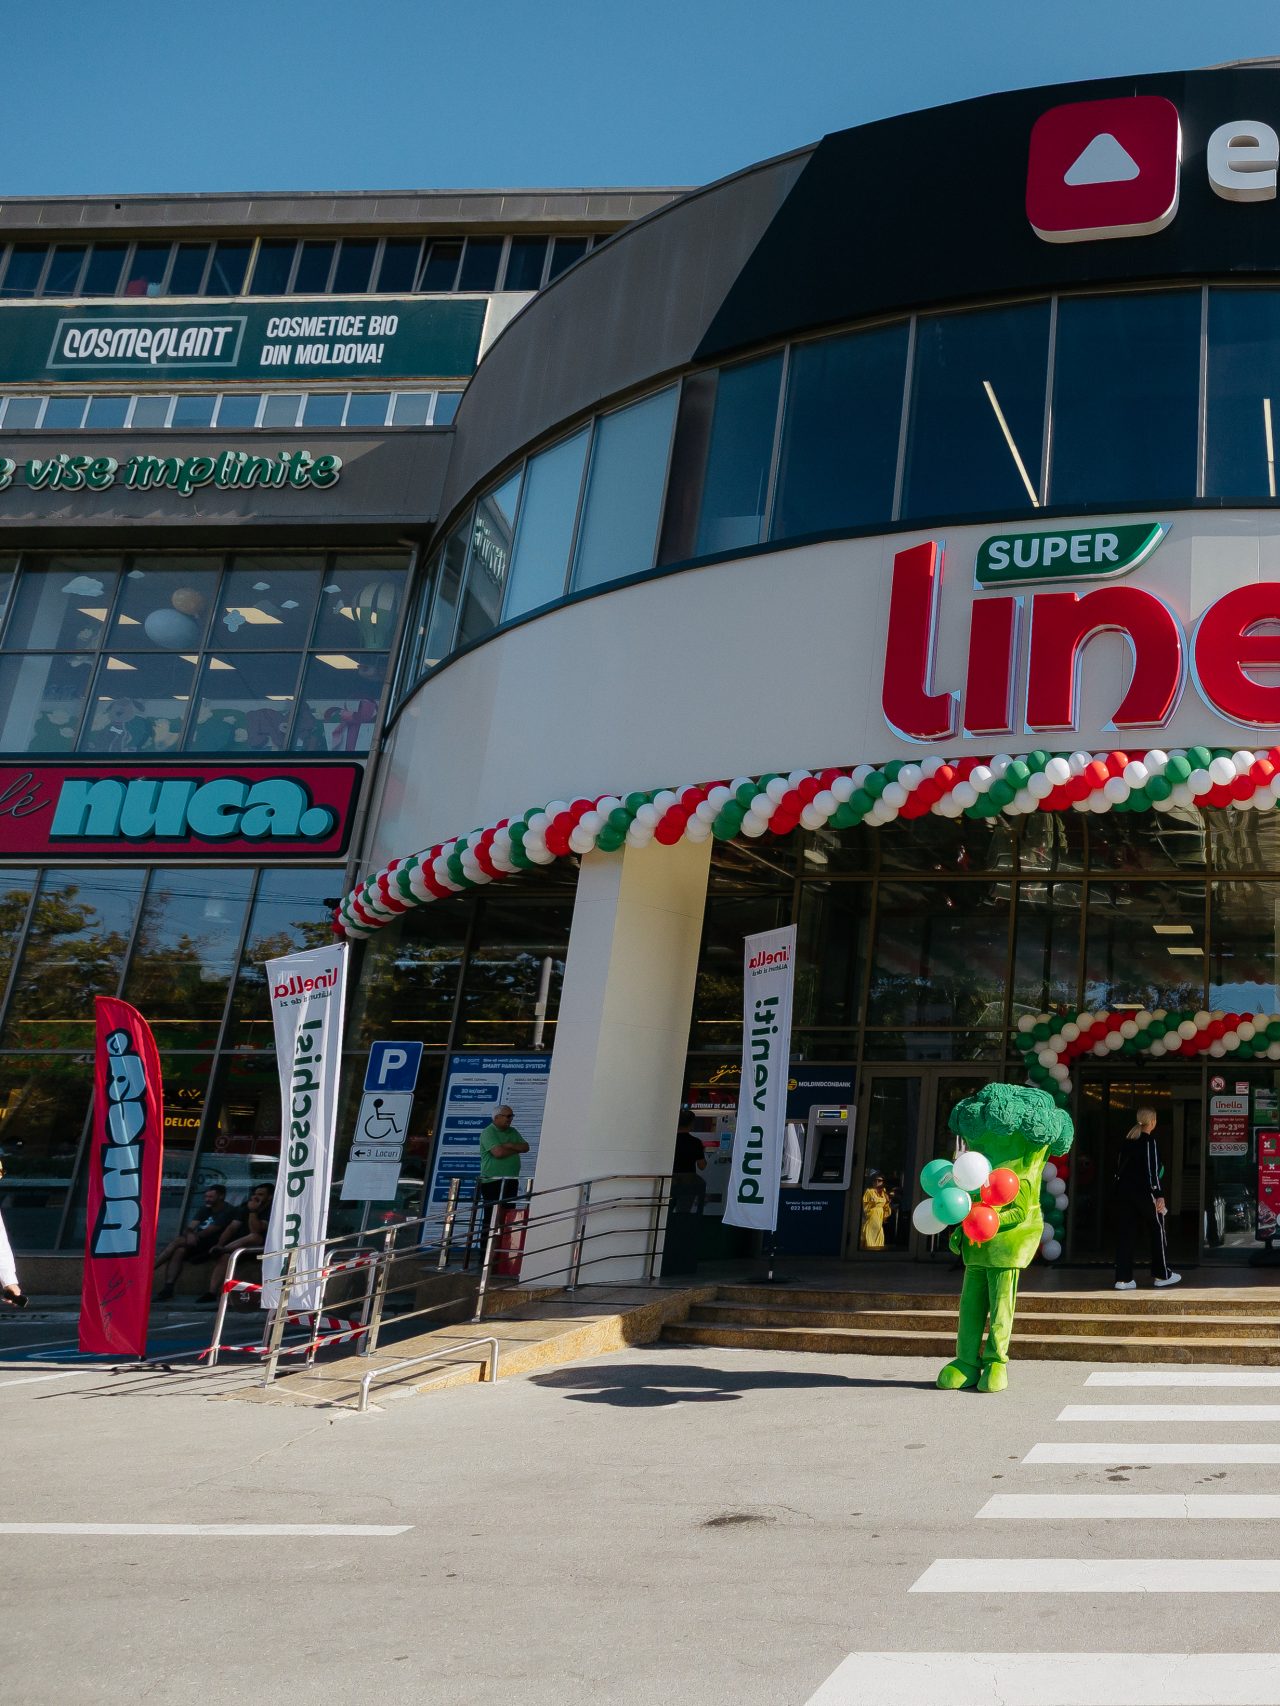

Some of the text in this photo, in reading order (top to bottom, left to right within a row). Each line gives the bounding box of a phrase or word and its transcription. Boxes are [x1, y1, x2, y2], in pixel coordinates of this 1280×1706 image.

[267, 315, 398, 338] COSMETICE BIO
[260, 343, 384, 365] DIN MOLDOVA!
[25, 454, 118, 491] vise
[988, 533, 1119, 570] SUPER
[378, 1049, 408, 1084] P
[1215, 1100, 1243, 1108] linella
[367, 1149, 371, 1157] 3
